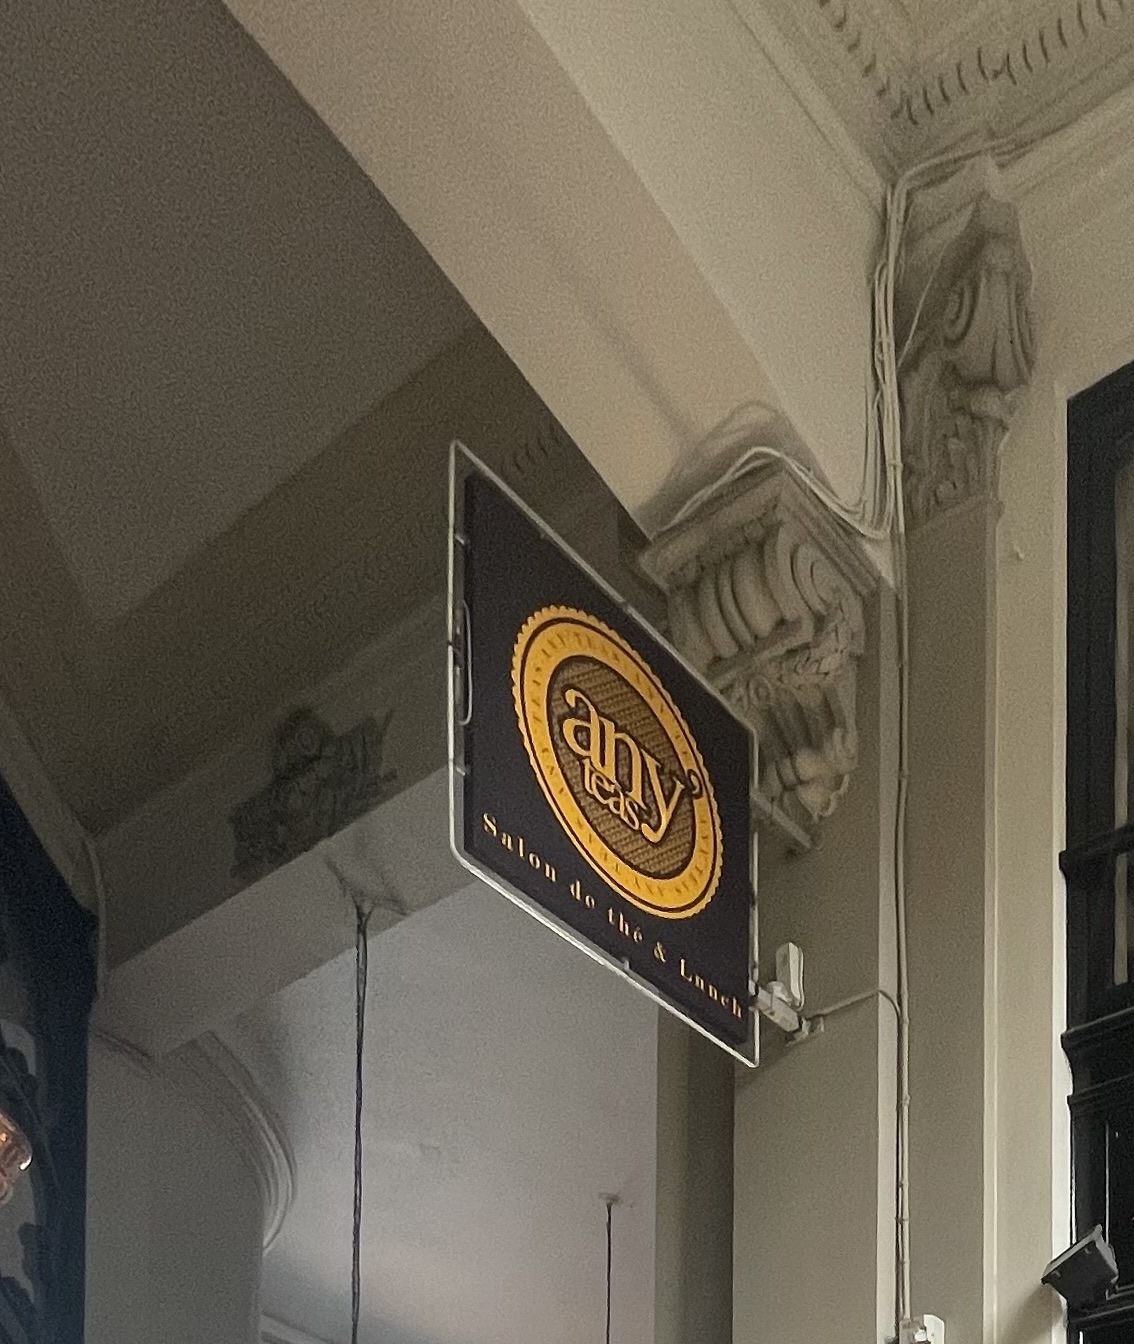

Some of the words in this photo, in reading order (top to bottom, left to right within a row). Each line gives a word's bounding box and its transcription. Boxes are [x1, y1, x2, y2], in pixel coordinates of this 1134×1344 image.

[583, 757, 640, 832] teas
[482, 812, 557, 882] Salon
[608, 907, 643, 943] thé
[653, 941, 667, 963] &
[680, 958, 743, 1018] Lunch
